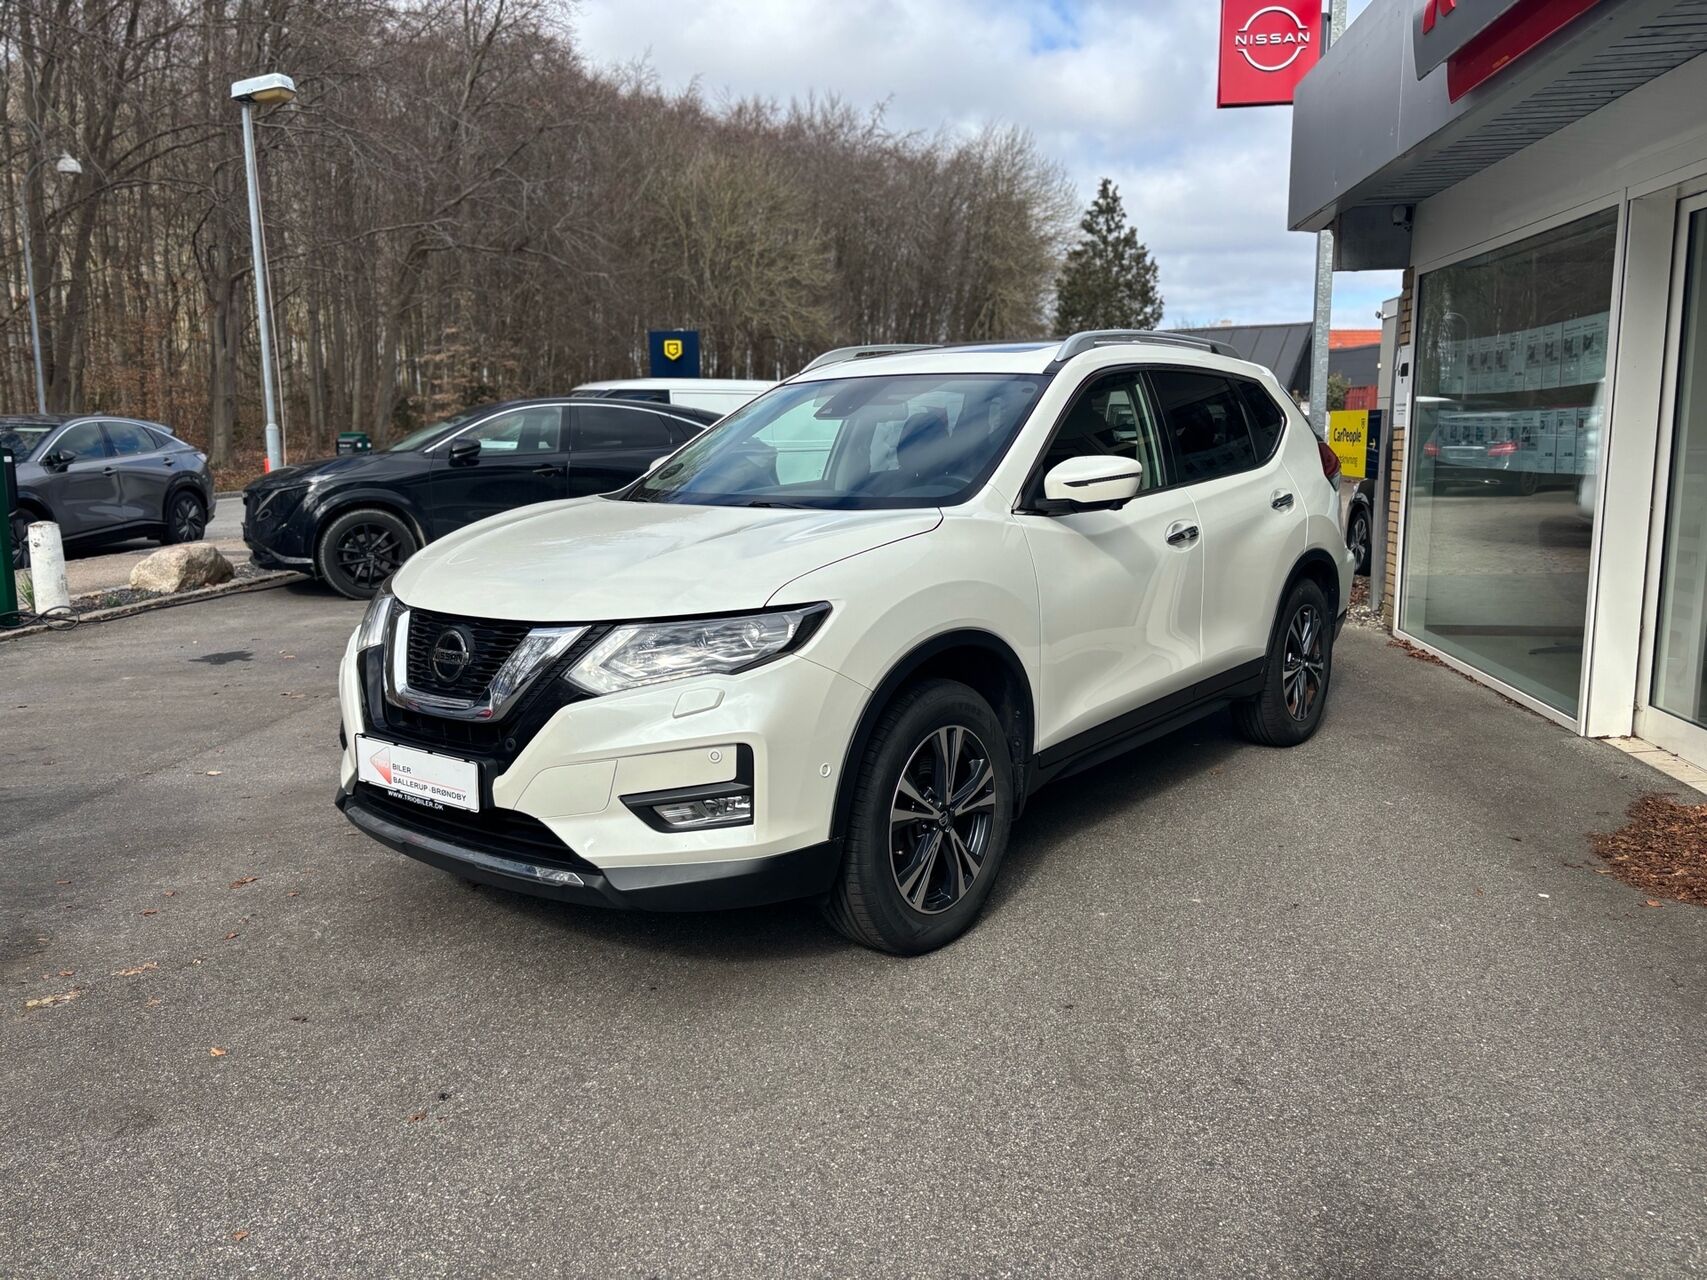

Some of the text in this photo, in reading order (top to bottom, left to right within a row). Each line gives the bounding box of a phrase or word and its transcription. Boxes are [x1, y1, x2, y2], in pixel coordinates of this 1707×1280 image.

[1235, 32, 1310, 45] NISSAN
[1334, 428, 1361, 447] CarPeople
[392, 763, 412, 774] BILER
